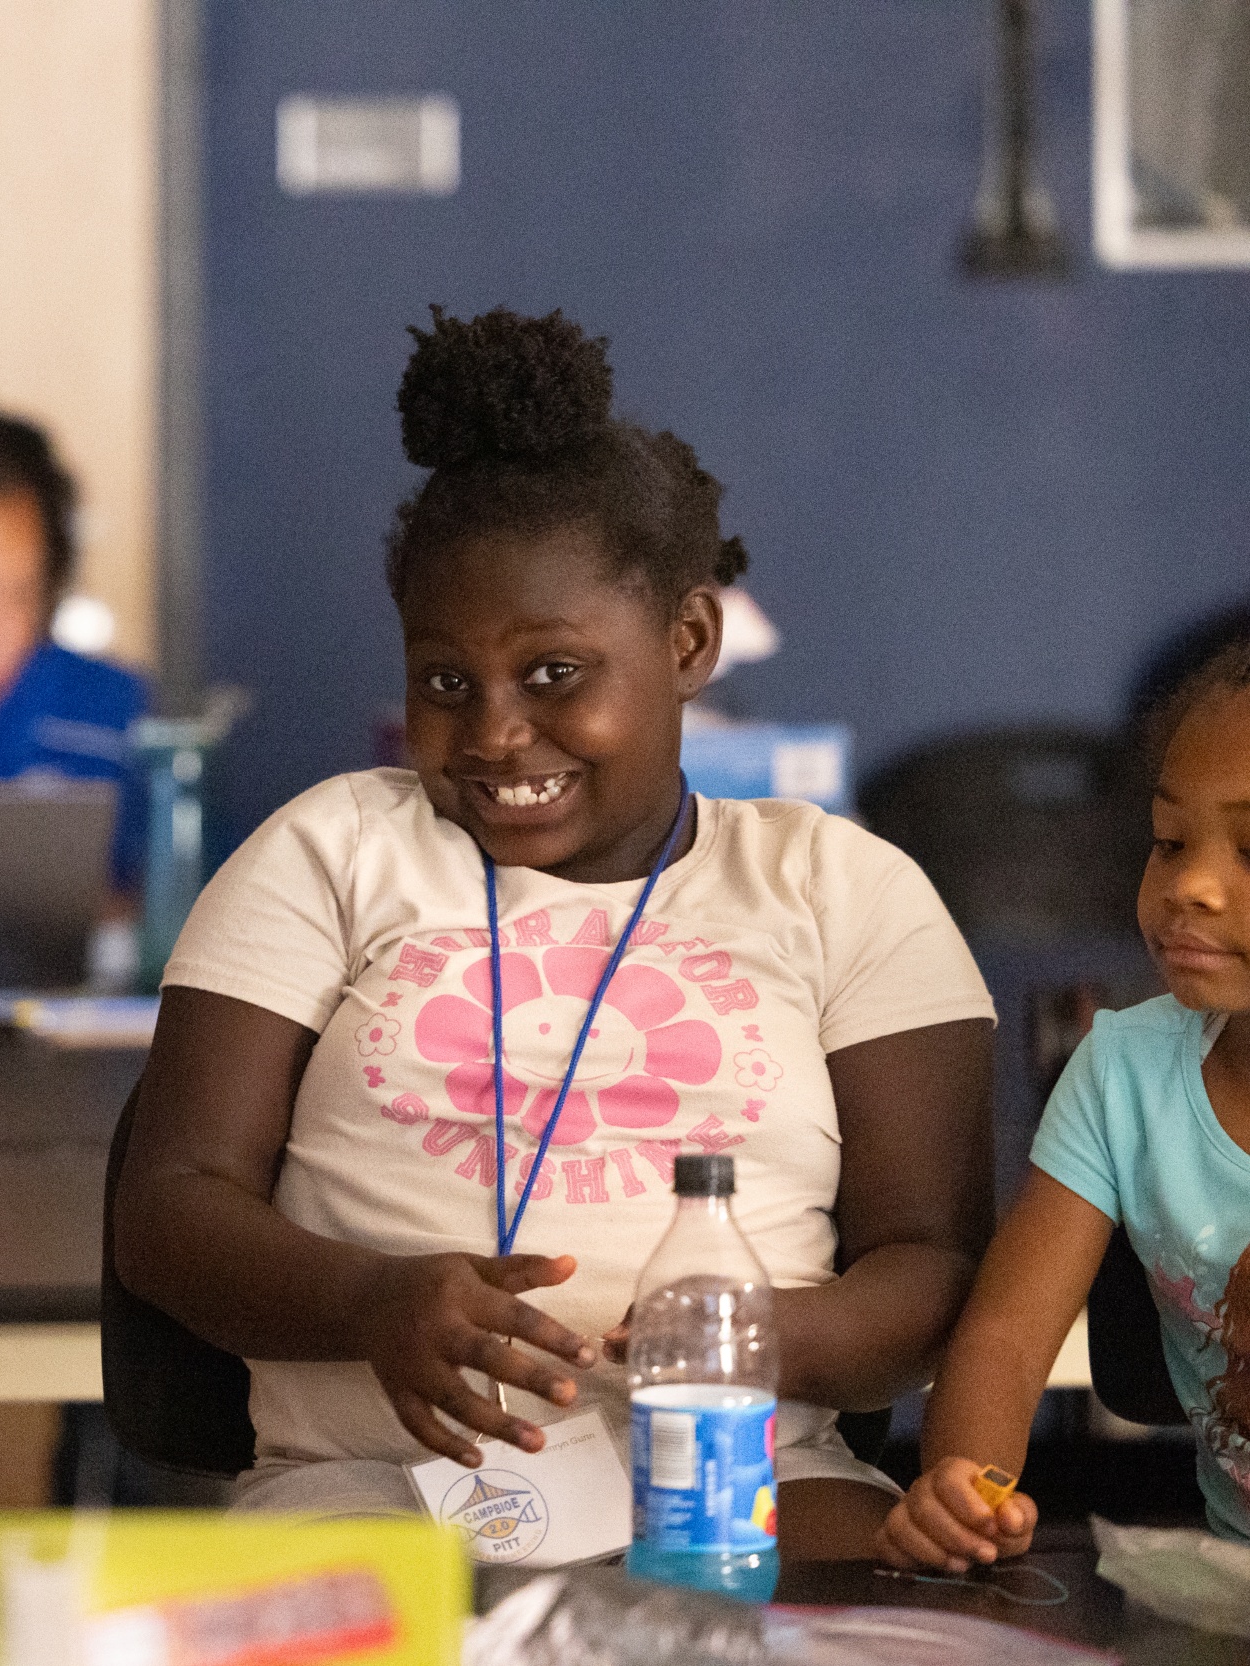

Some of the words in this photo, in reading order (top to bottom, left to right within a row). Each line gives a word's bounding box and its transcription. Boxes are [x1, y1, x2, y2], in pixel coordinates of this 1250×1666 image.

[463, 1498, 521, 1524] CAMPBIOE
[489, 1521, 510, 1535] 2.0
[493, 1537, 521, 1553] PITT
